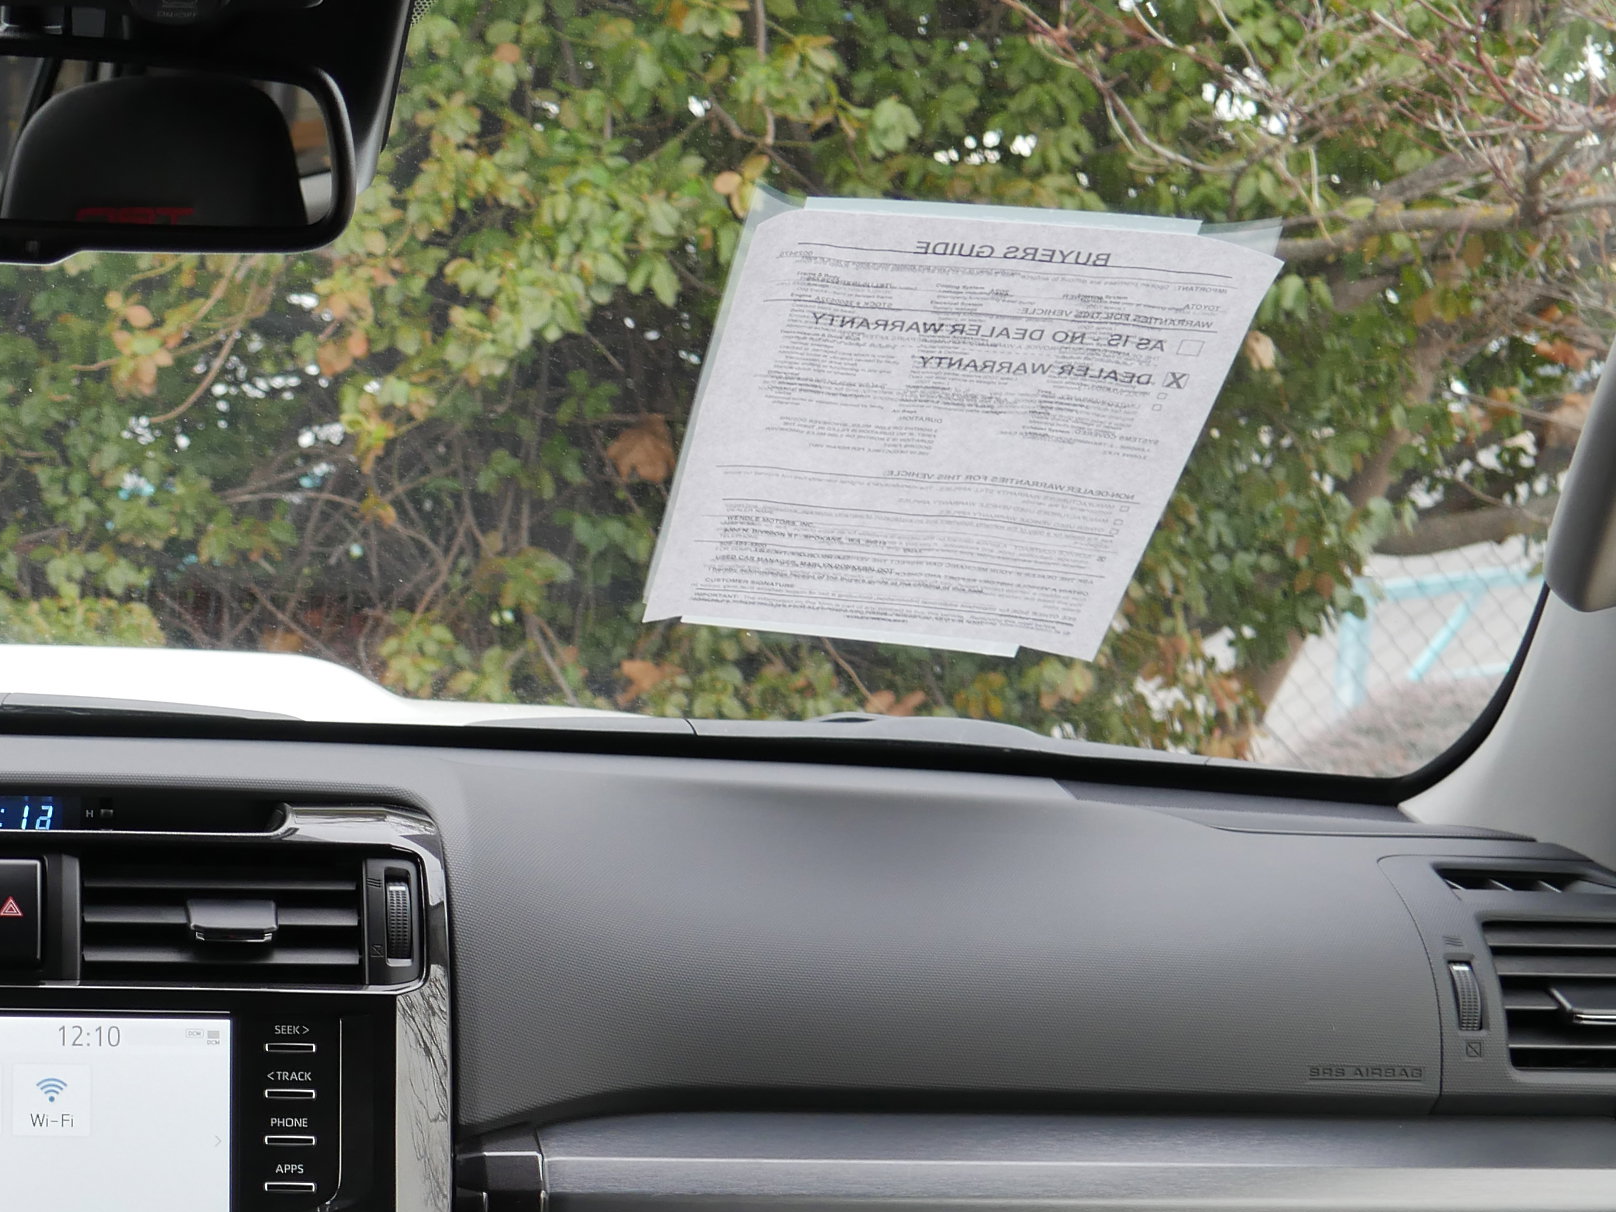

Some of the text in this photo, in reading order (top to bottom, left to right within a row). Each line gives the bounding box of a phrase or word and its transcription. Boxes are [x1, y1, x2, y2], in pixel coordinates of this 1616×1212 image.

[58, 1025, 122, 1048] 12:10
[1308, 1067, 1424, 1080] SRS AIRBAG
[30, 1113, 74, 1128] Wi-Fi
[270, 1117, 308, 1128] PHONE
[275, 1164, 304, 1174] APPS
